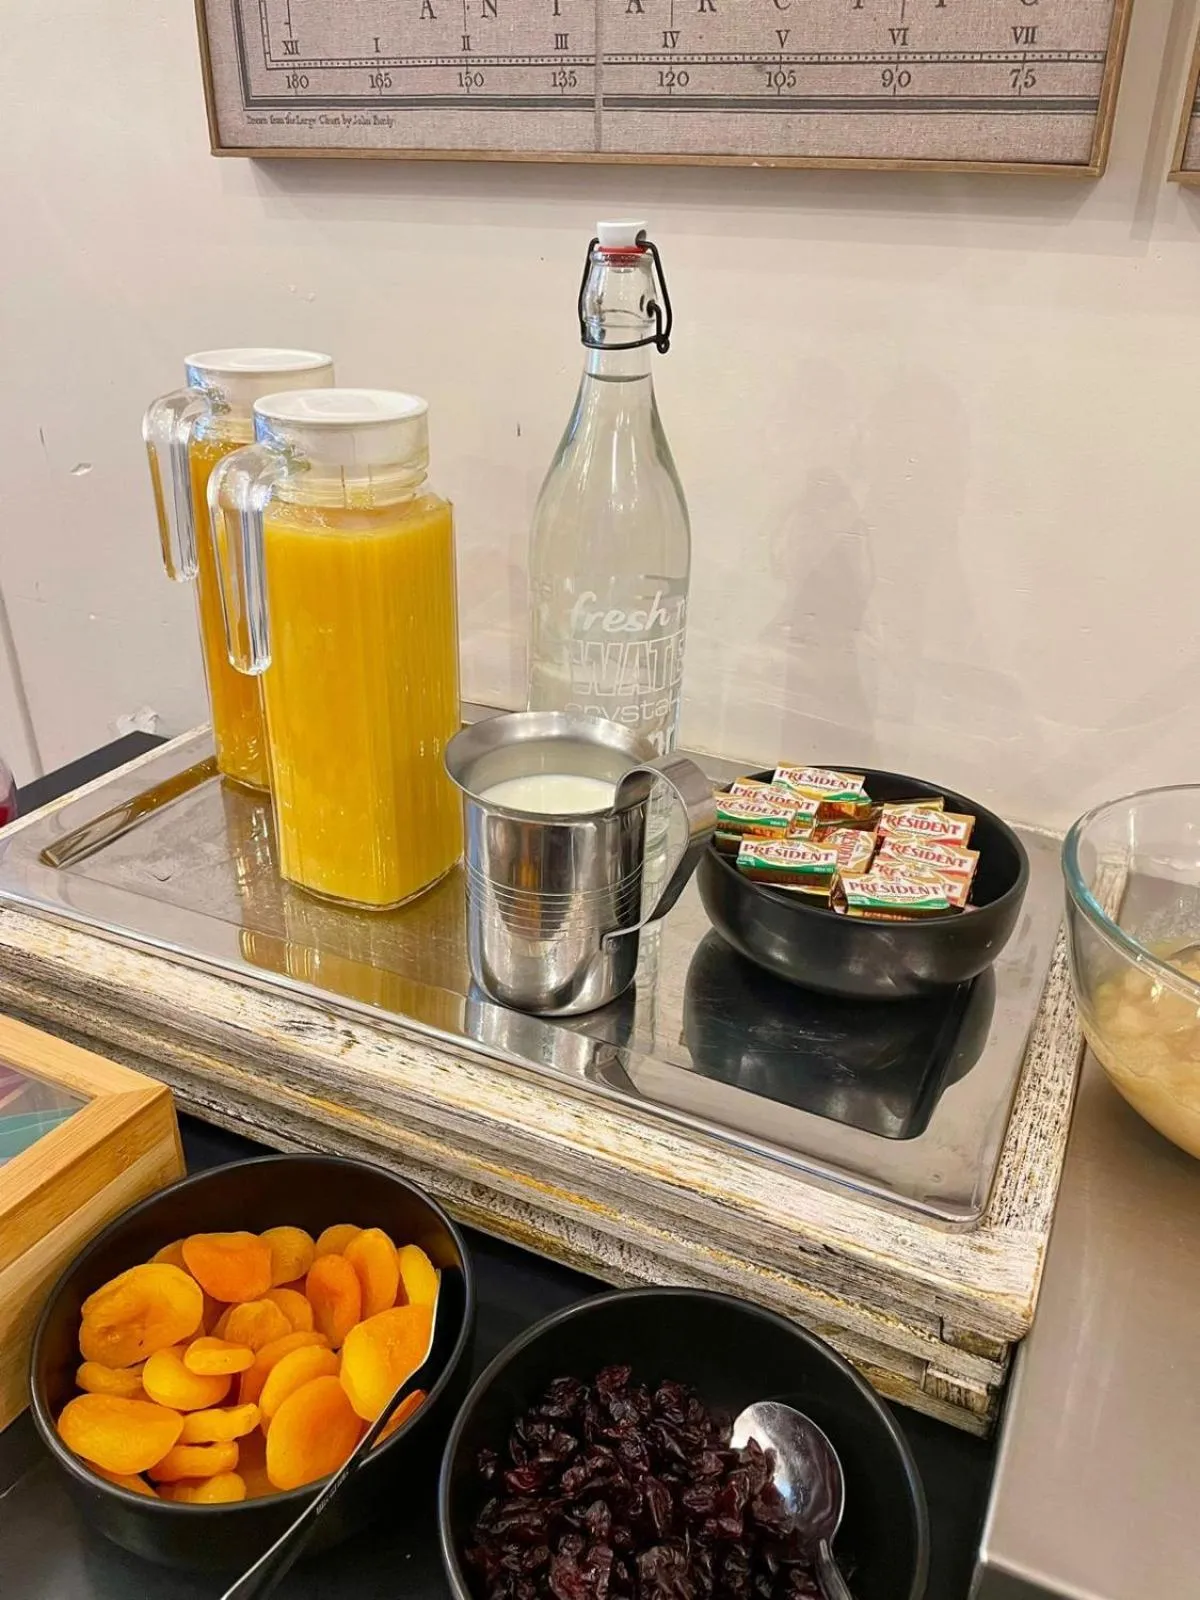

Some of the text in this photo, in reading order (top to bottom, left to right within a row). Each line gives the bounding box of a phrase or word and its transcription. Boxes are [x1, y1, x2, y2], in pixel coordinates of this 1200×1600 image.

[282, 26, 1038, 55] XII I II III IV V VI VII
[285, 68, 1037, 89] 180 165 150 135 120 105 90 75
[570, 590, 671, 634] fresh
